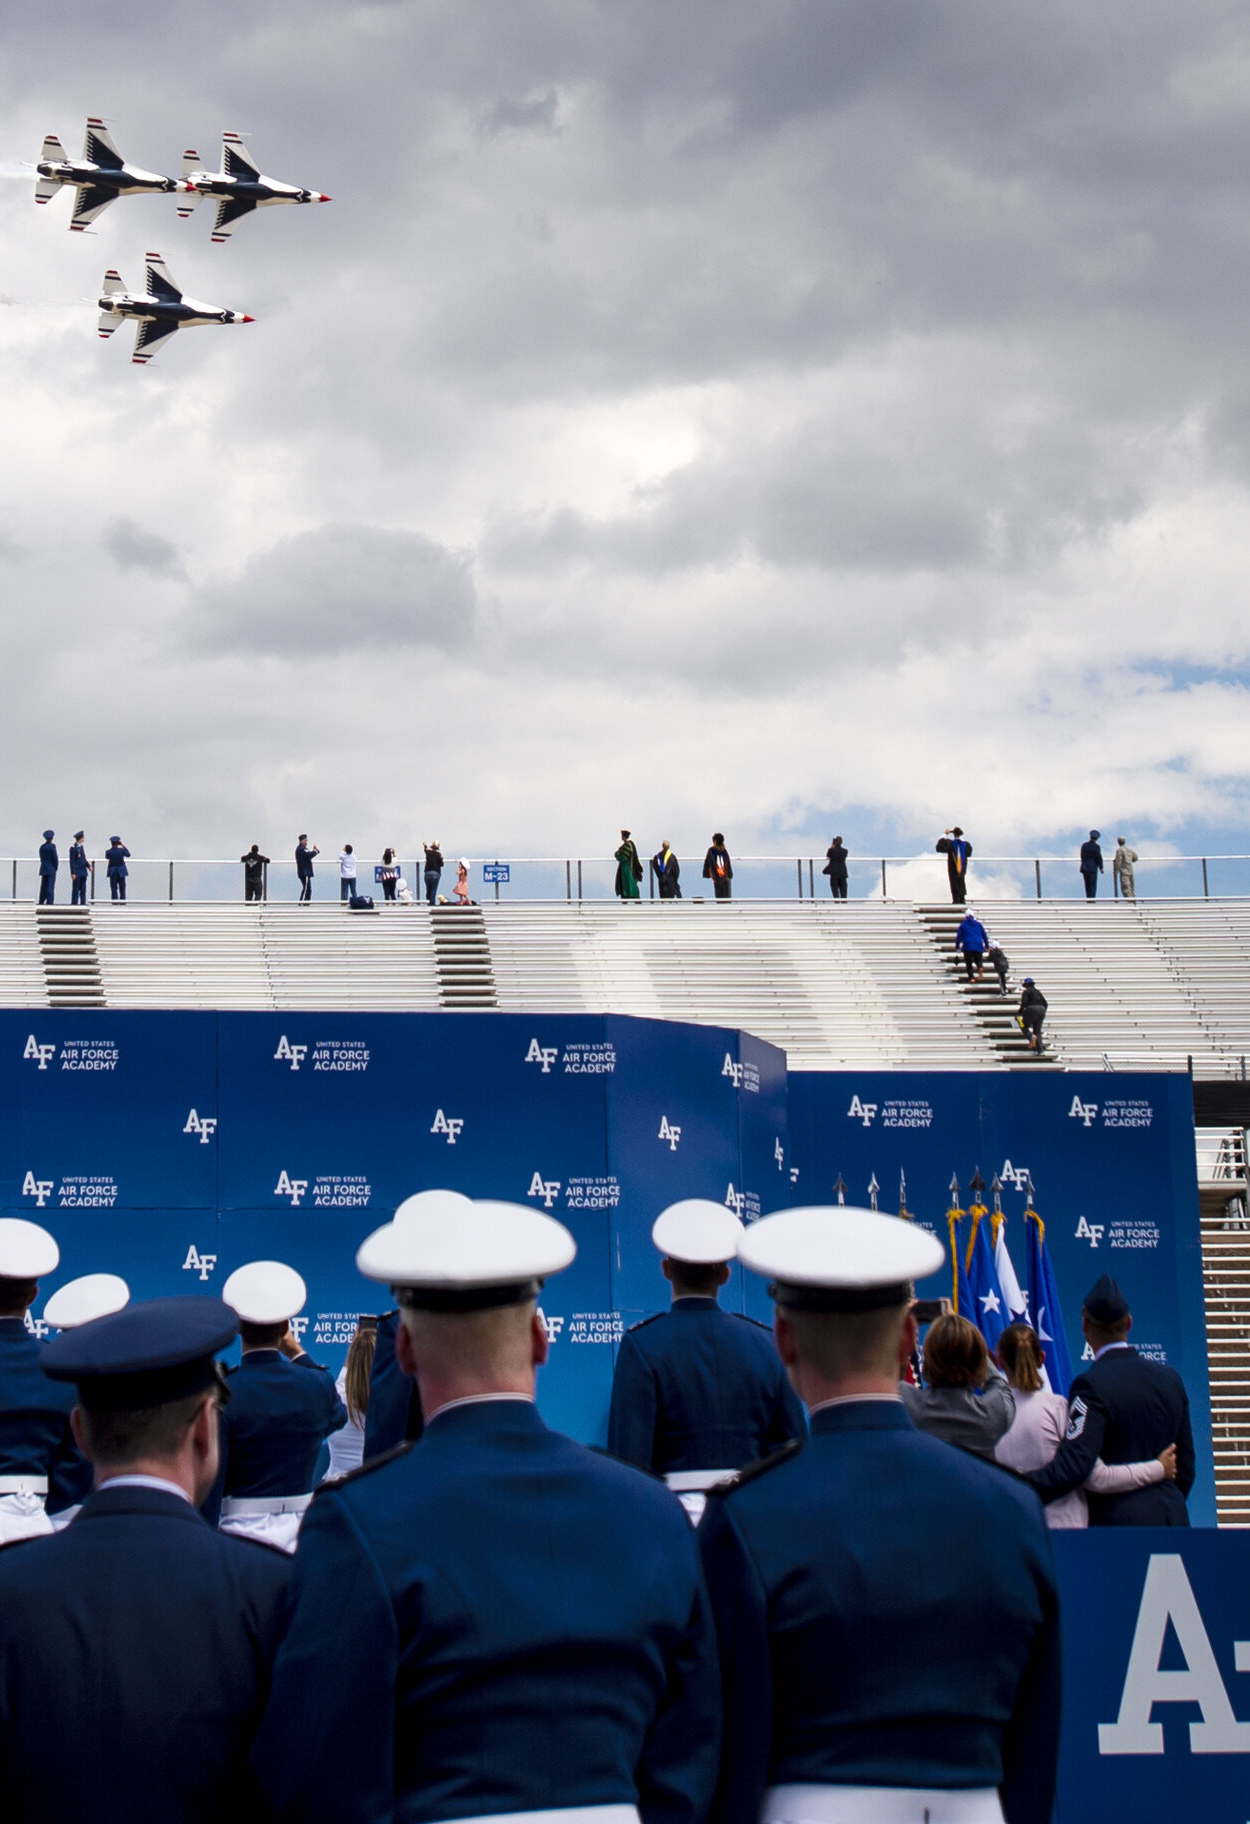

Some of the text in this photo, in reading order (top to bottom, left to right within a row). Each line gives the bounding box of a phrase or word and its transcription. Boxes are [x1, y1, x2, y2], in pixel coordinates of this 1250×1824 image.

[485, 873, 508, 881] M-23
[23, 1034, 55, 1070] AF
[60, 1050, 118, 1059] AIR FORCE
[273, 1035, 307, 1070] AF
[312, 1050, 369, 1060] AIR FORCE
[524, 1038, 558, 1073] AF
[562, 1052, 616, 1062] AIR FORCE
[61, 1061, 116, 1070] ACADEMY
[314, 1061, 367, 1071] ACADEMY
[564, 1063, 614, 1073] ACADEMY
[722, 1052, 743, 1087] AF
[847, 1095, 877, 1126] AF
[881, 1109, 933, 1118] AIR FORCE
[1068, 1095, 1097, 1127] AF
[1102, 1108, 1153, 1117] AIR FORCE
[183, 1109, 216, 1143] AF
[430, 1109, 463, 1144] AF
[883, 1119, 931, 1128] ACADEMY
[1104, 1119, 1151, 1127] ACADEMY
[658, 1115, 681, 1150] AF
[999, 1158, 1029, 1191] AF
[22, 1171, 53, 1206] AF
[58, 1186, 117, 1196] AIR FORCE
[273, 1170, 308, 1206] AF
[312, 1185, 371, 1194] AIR FORCE
[527, 1172, 560, 1207] AF
[565, 1185, 619, 1196] AIR FORCE
[60, 1197, 115, 1207] ACADEMY
[314, 1196, 369, 1206] ACADEMY
[567, 1198, 618, 1208] ACADEMY
[724, 1182, 745, 1218] AF
[1074, 1216, 1104, 1248] AF
[1108, 1229, 1159, 1238] AIR FORCE
[1110, 1240, 1158, 1248] ACADEMY
[182, 1245, 216, 1280] AF
[314, 1322, 358, 1332] AIR FOR
[569, 1321, 623, 1331] AIR FORCE
[316, 1333, 354, 1343] ACADE
[571, 1333, 622, 1343] ACADEMY
